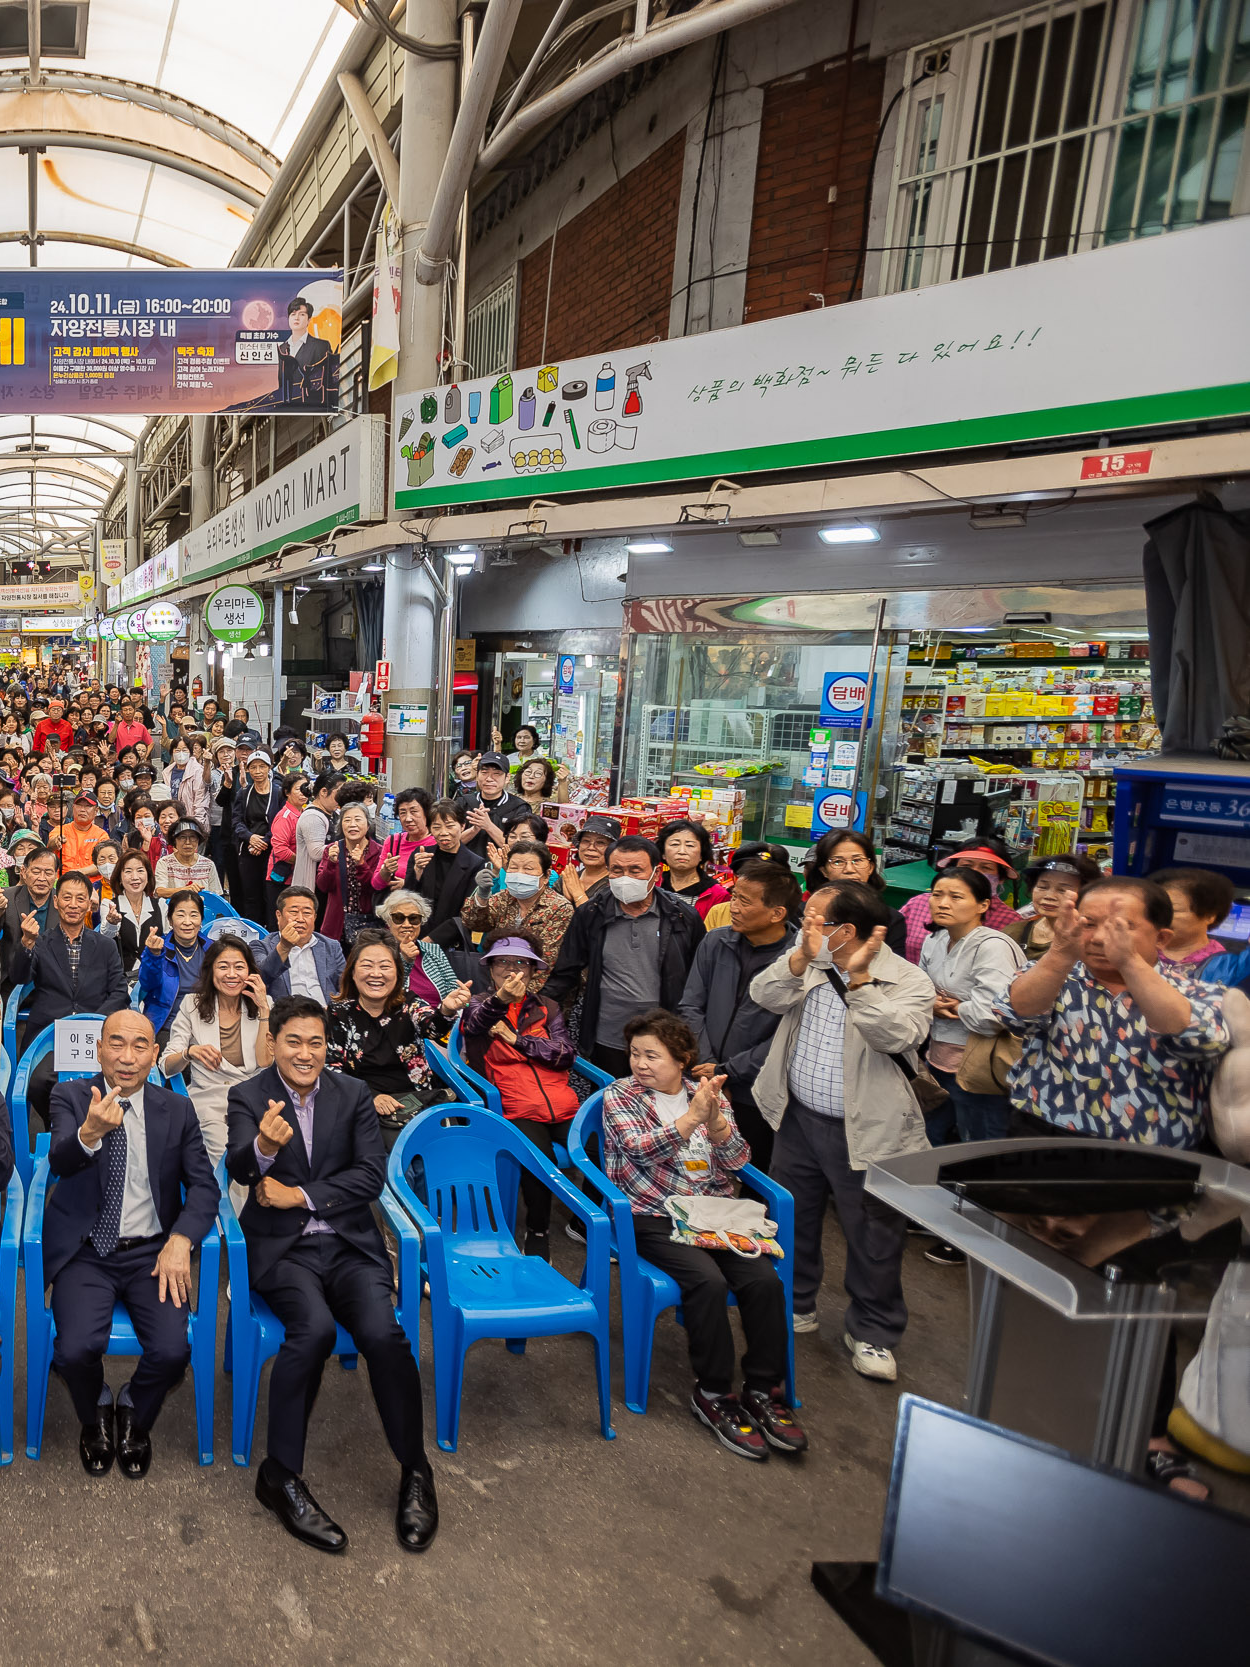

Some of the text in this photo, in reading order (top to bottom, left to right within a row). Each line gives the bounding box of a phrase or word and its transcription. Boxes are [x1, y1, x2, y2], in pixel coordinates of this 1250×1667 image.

[50, 294, 231, 316] 24.10.11.(금) 16:00~20:00
[50, 318, 176, 338] 자양전통시장 내
[53, 347, 70, 357] 고객
[73, 347, 91, 357] 감사
[121, 346, 139, 357] 행사
[177, 346, 214, 356] 맥주 축제
[240, 351, 273, 361] 신 인 선
[688, 379, 744, 404] 상품의
[753, 366, 830, 398] 백화점~
[841, 353, 883, 380] 뭐든
[899, 353, 918, 364] 다
[1100, 455, 1125, 472] 15
[206, 445, 350, 552] 우리마트생선 WOORI MART
[213, 598, 256, 611] 우리마트
[224, 613, 245, 625] 생선
[833, 687, 865, 700] 담배
[1166, 799, 1221, 813] 은행공동
[70, 1033, 94, 1045] 이 동
[70, 1049, 94, 1059] 구 의
